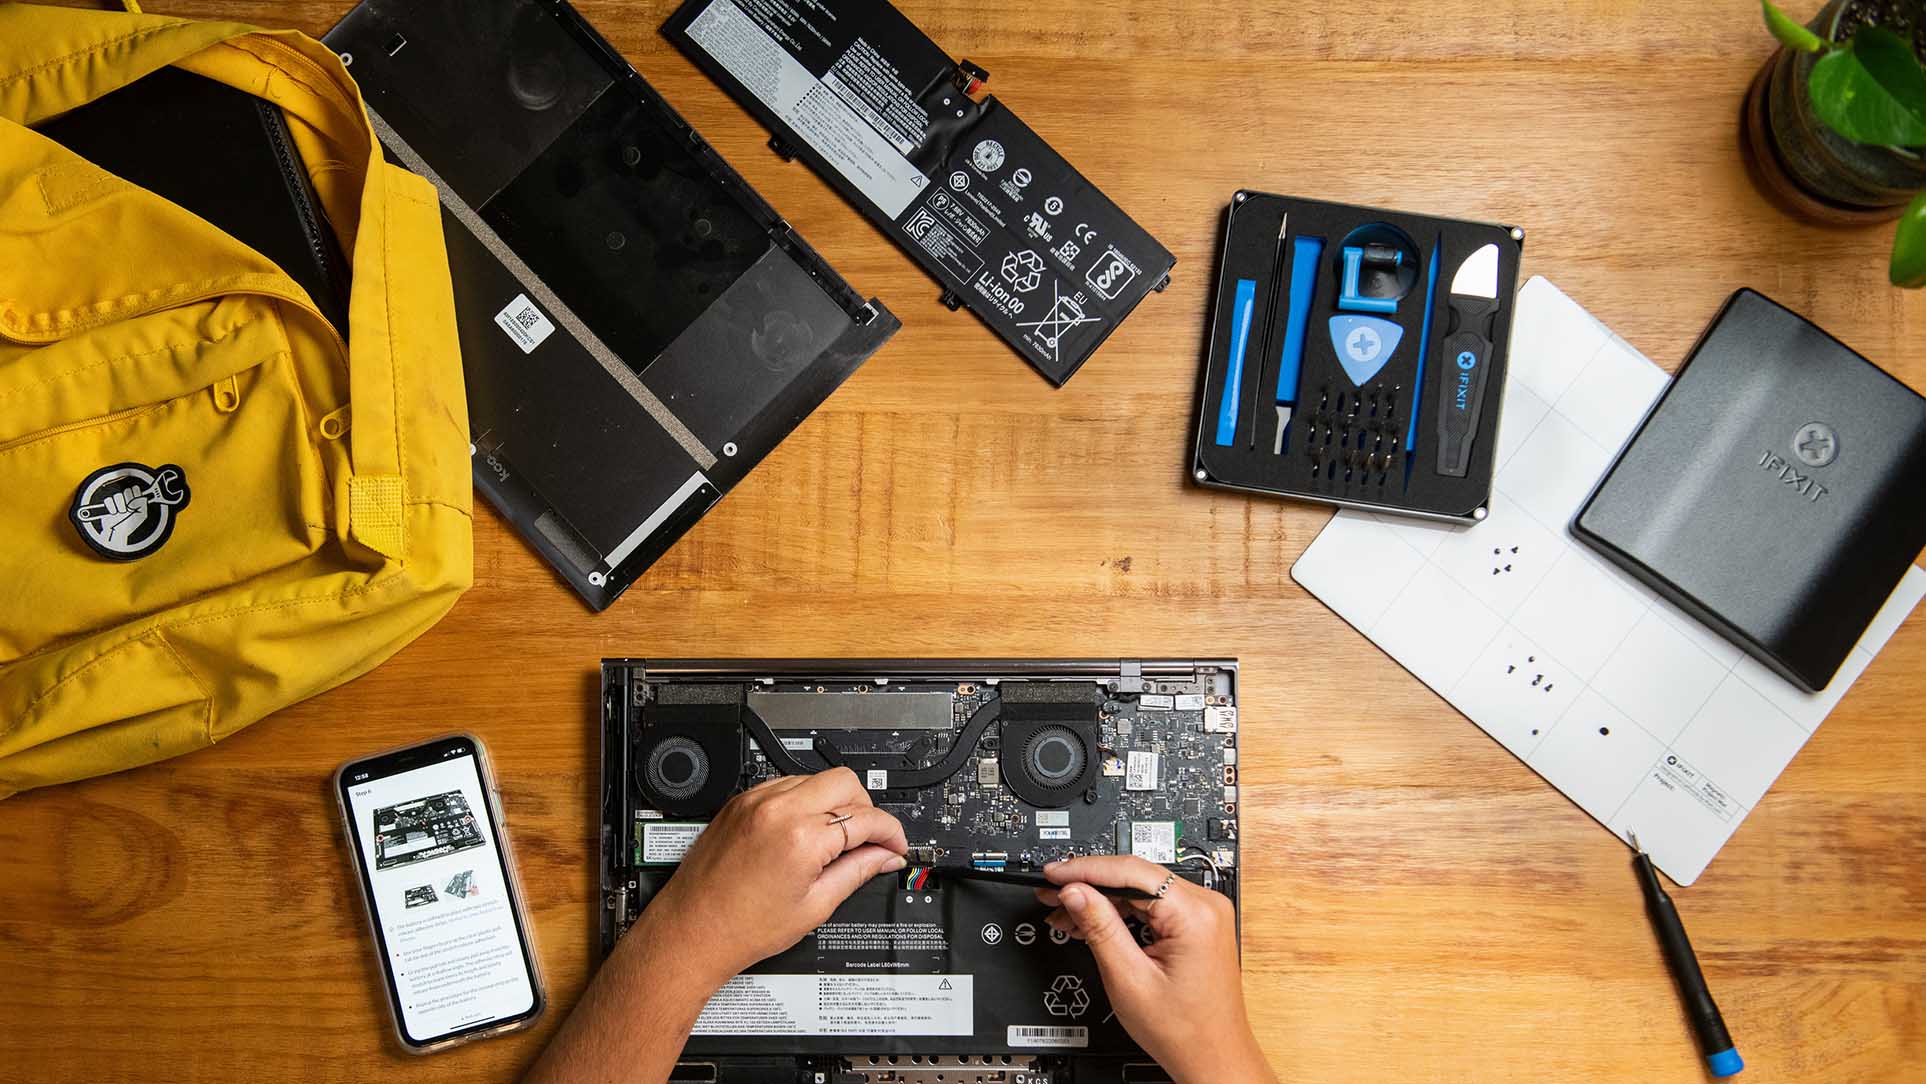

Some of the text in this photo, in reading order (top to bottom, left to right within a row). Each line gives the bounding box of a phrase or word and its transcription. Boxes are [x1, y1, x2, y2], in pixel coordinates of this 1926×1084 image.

[1042, 231, 1053, 242] US
[1072, 220, 1098, 245] CE
[977, 270, 1025, 315] Li-ion 00
[1072, 290, 1088, 306] EU
[1455, 372, 1467, 410] IFIXIT
[1759, 450, 1829, 503] IFIXIT
